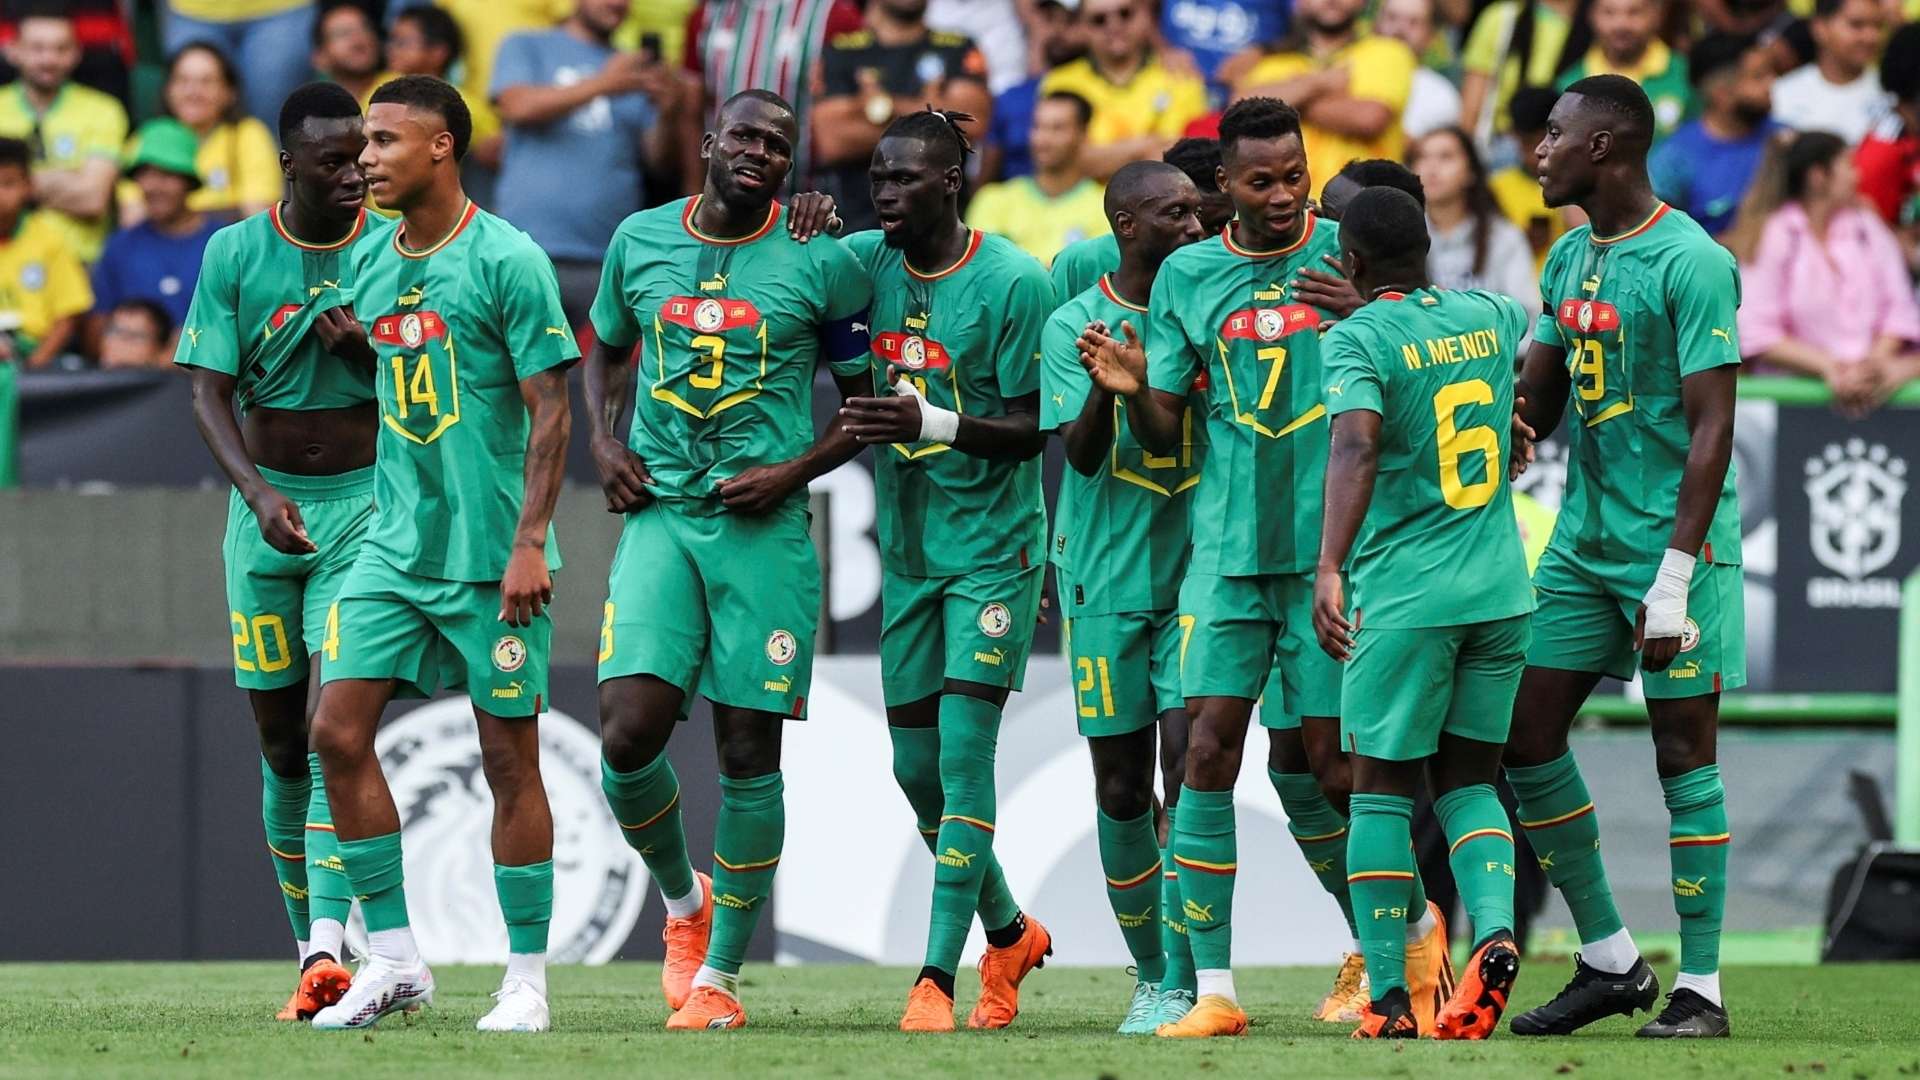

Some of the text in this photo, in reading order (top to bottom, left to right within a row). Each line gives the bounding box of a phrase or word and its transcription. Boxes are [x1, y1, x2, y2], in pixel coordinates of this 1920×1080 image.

[1254, 290, 1280, 301] PUMA
[689, 334, 725, 390] 3
[1257, 346, 1287, 410] 7
[1402, 328, 1500, 370] N.MENDY
[1569, 337, 1605, 401] 19
[391, 352, 439, 420] 14
[1433, 378, 1500, 511] 6
[231, 610, 292, 673] 20
[973, 651, 1000, 666] PUMA
[1179, 614, 1196, 676] 7
[491, 687, 519, 698] PUMA
[765, 679, 789, 693] PUMA
[1076, 656, 1116, 718] 21
[1669, 668, 1697, 679] PUMA
